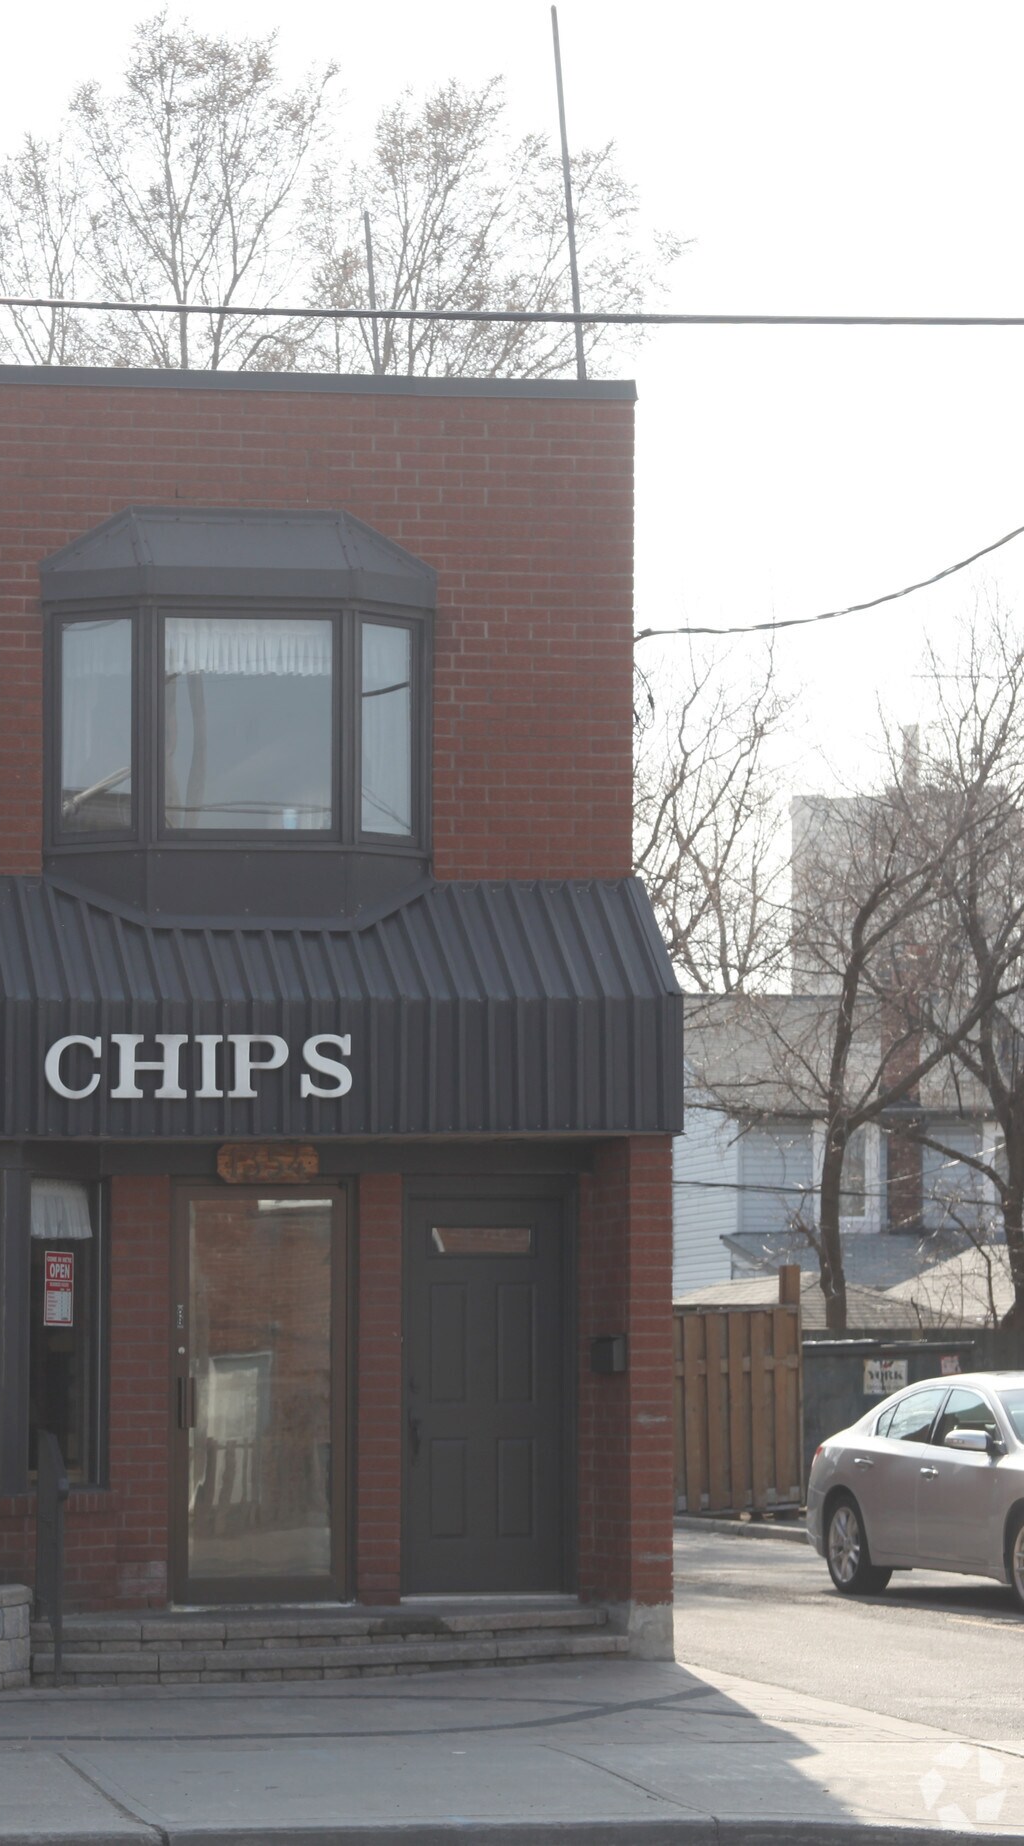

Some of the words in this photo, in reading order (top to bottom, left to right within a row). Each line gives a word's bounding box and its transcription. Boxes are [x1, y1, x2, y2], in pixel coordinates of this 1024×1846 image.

[44, 1033, 353, 1099] CHIPS
[49, 1263, 70, 1279] OPEN
[868, 1370, 903, 1381] YORK
